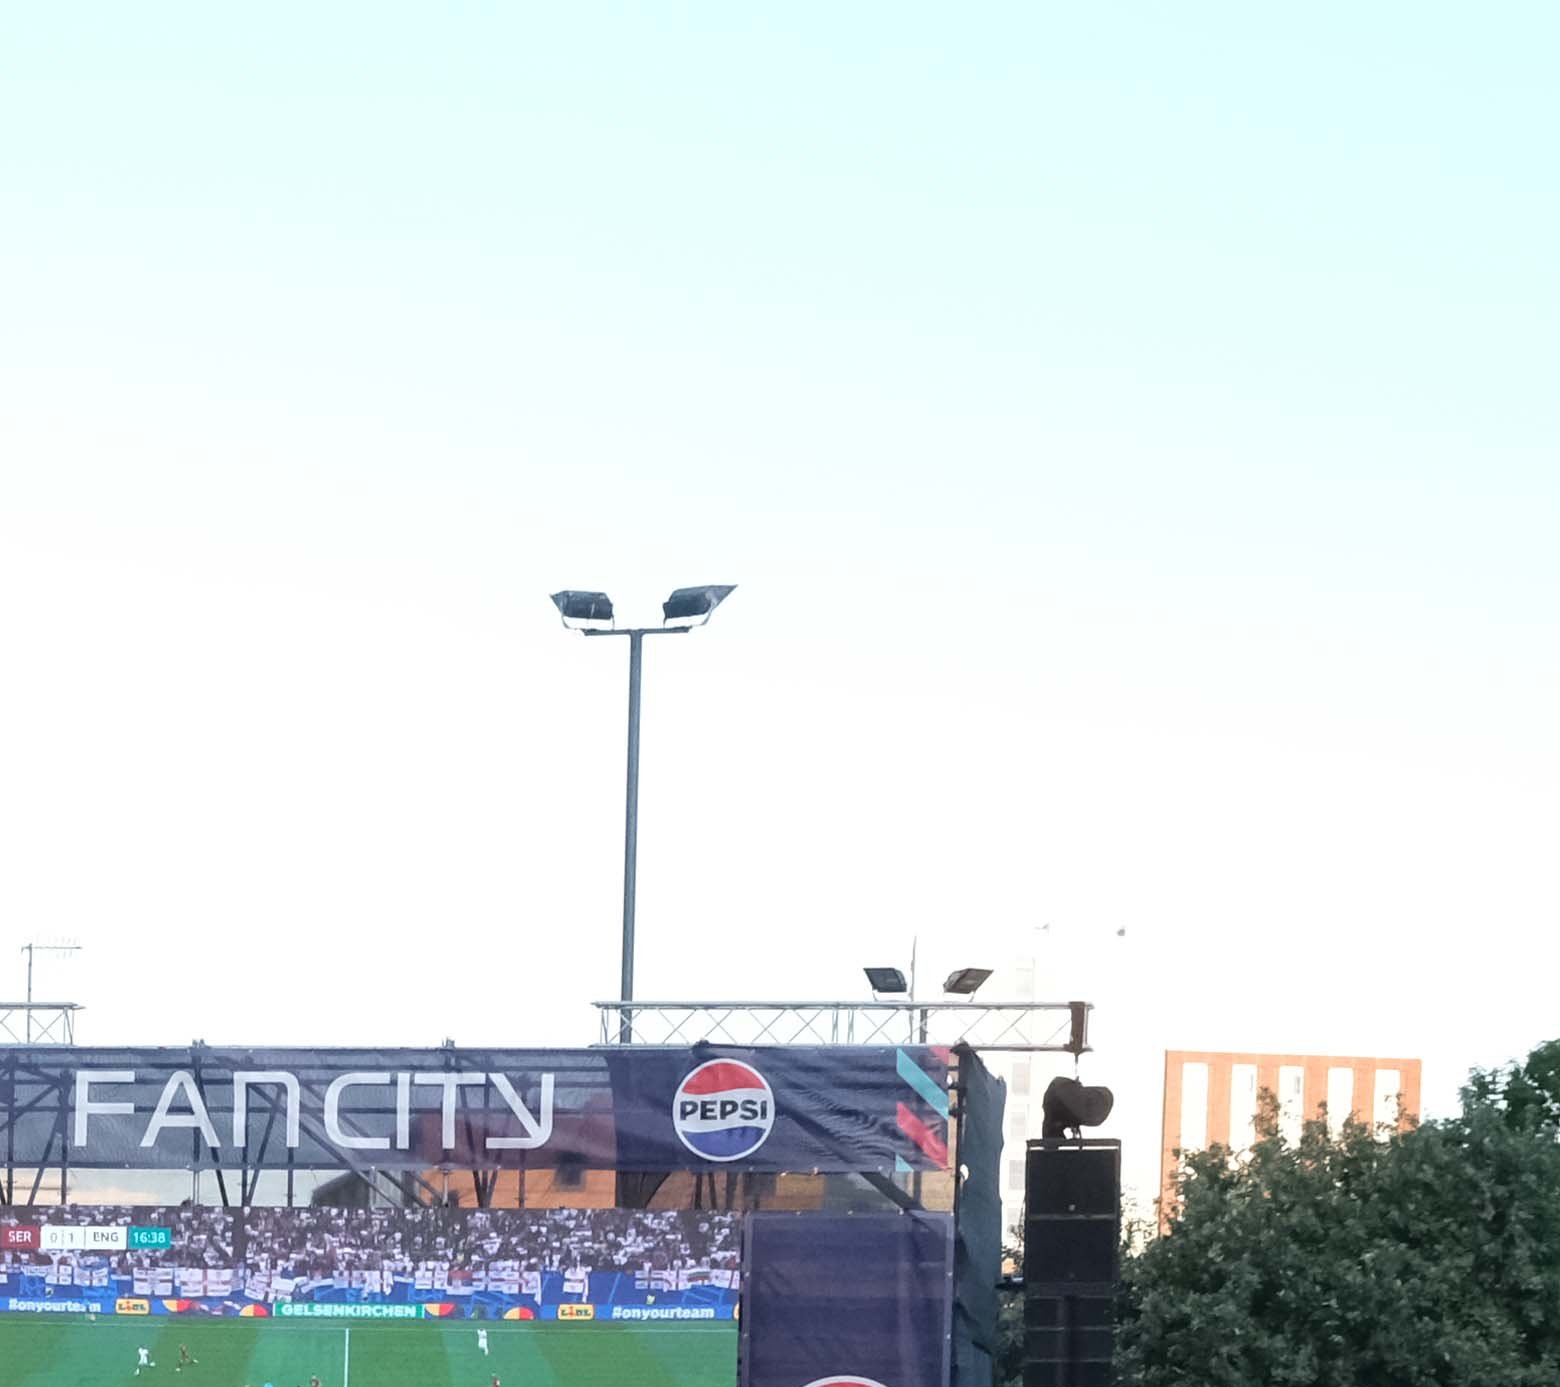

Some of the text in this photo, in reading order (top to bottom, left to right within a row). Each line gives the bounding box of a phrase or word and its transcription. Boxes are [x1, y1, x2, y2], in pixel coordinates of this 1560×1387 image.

[679, 1099, 767, 1121] PEPSI
[7, 1230, 32, 1243] SER
[92, 1233, 119, 1243] ENG
[132, 1231, 166, 1244] 16:38
[281, 1303, 417, 1317] GELSENKIRCHEN
